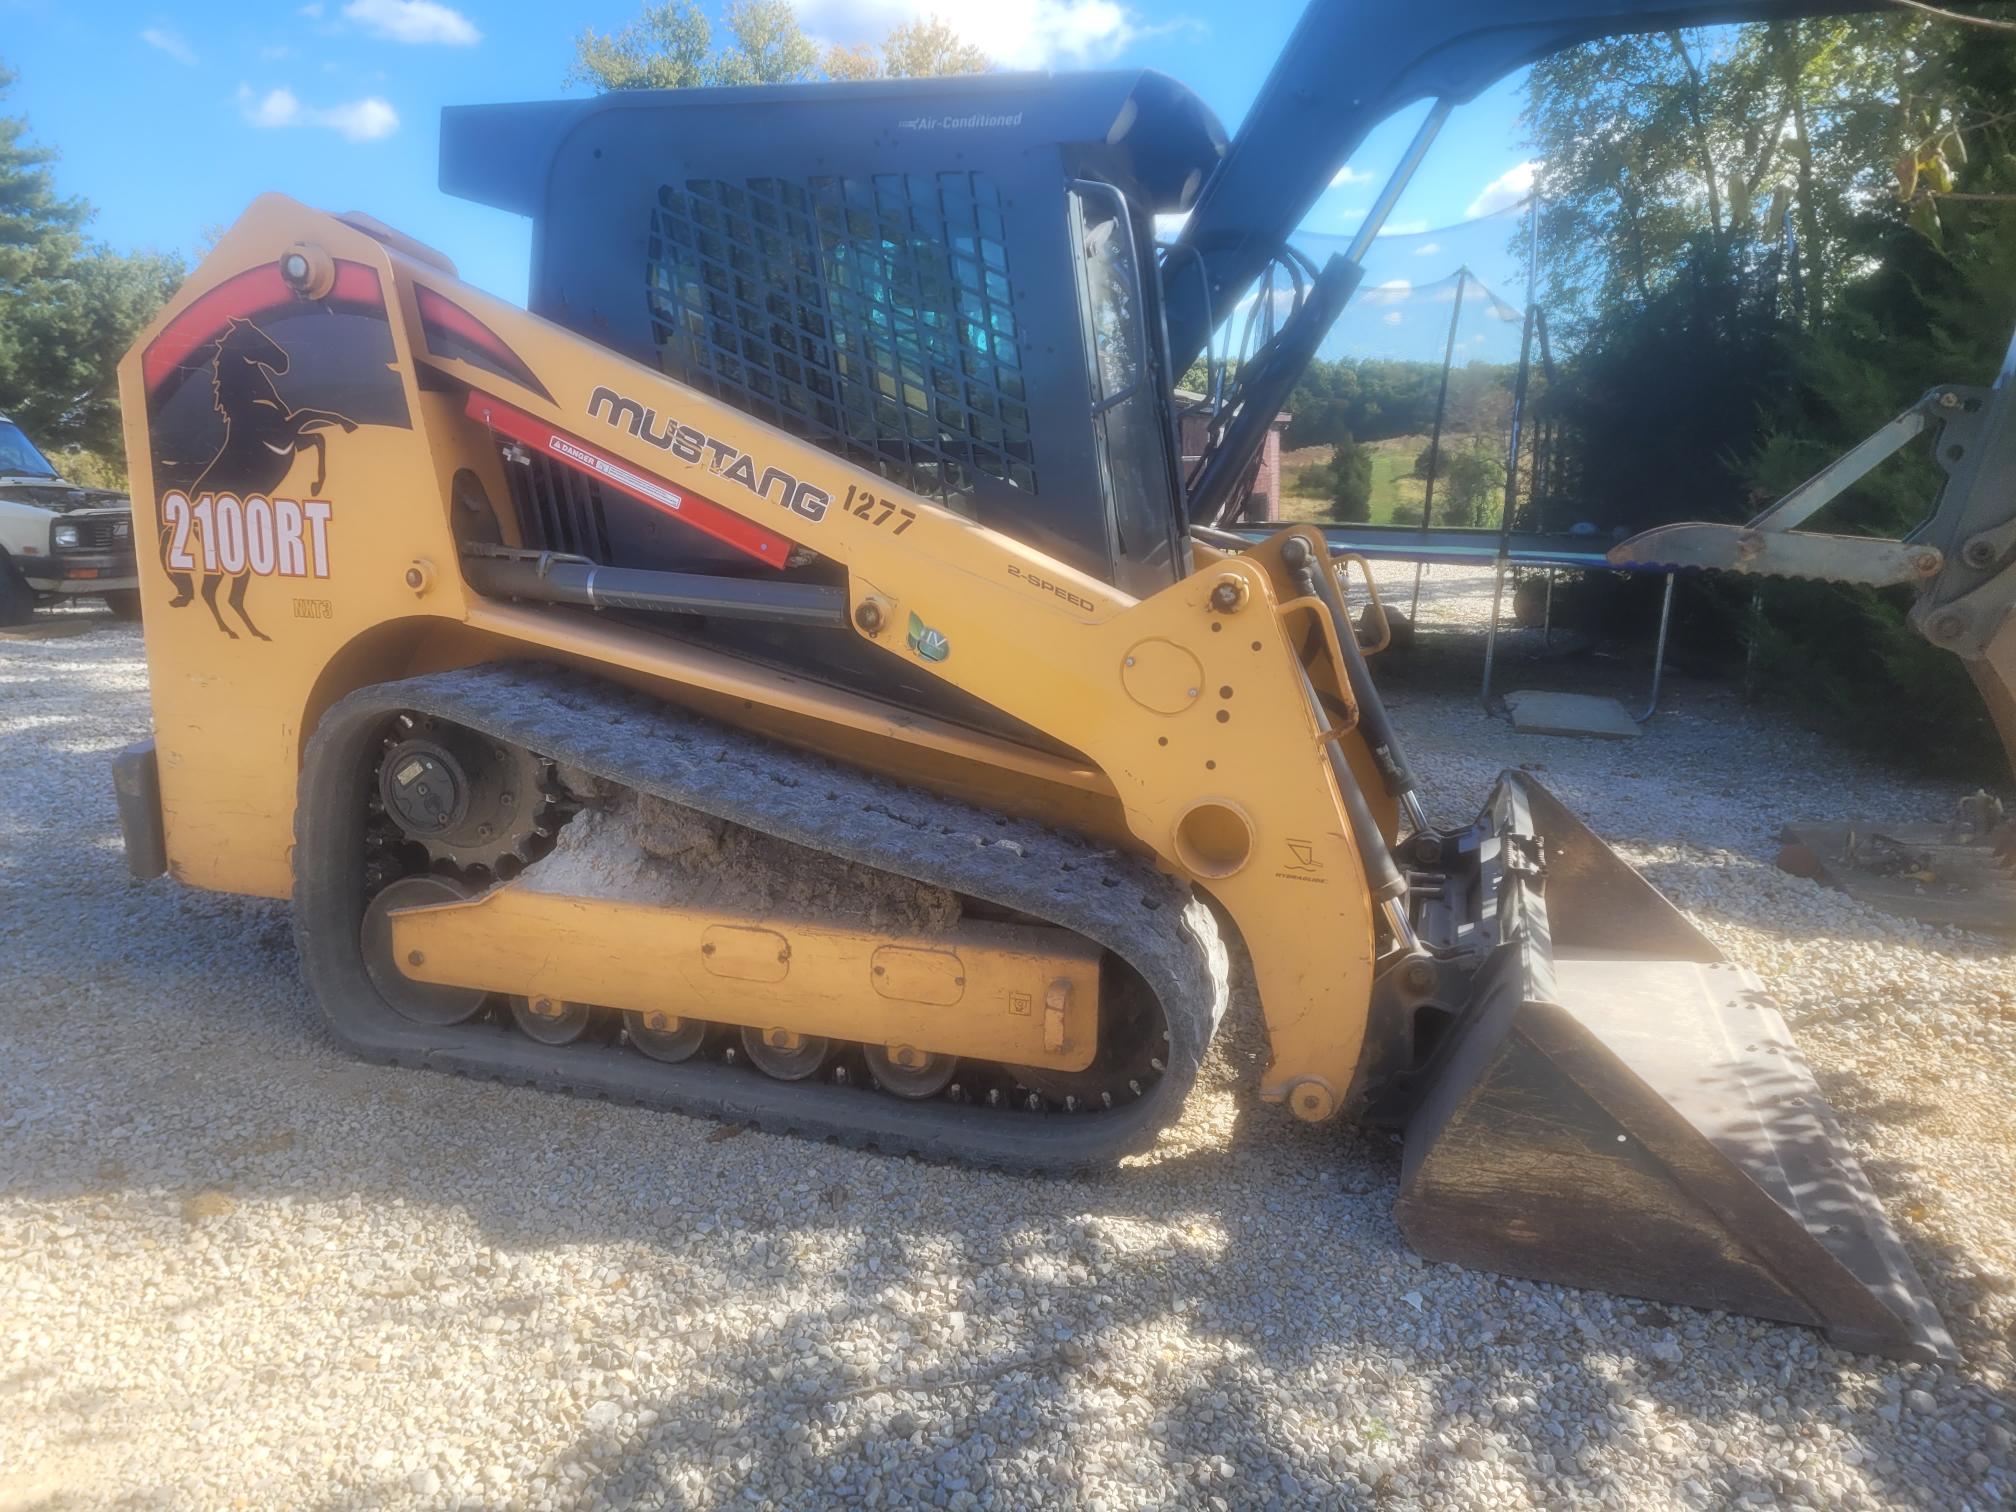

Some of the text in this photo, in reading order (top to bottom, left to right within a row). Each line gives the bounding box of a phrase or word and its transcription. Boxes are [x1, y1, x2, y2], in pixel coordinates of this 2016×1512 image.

[918, 112, 1023, 130] Air-Conditioned
[561, 443, 596, 466] DANGER
[586, 385, 833, 523] MUSTANG
[842, 484, 916, 536] 1277
[163, 490, 333, 580] 2100RT
[292, 598, 333, 619] NXT3
[1007, 564, 1095, 613] 2-SPEED
